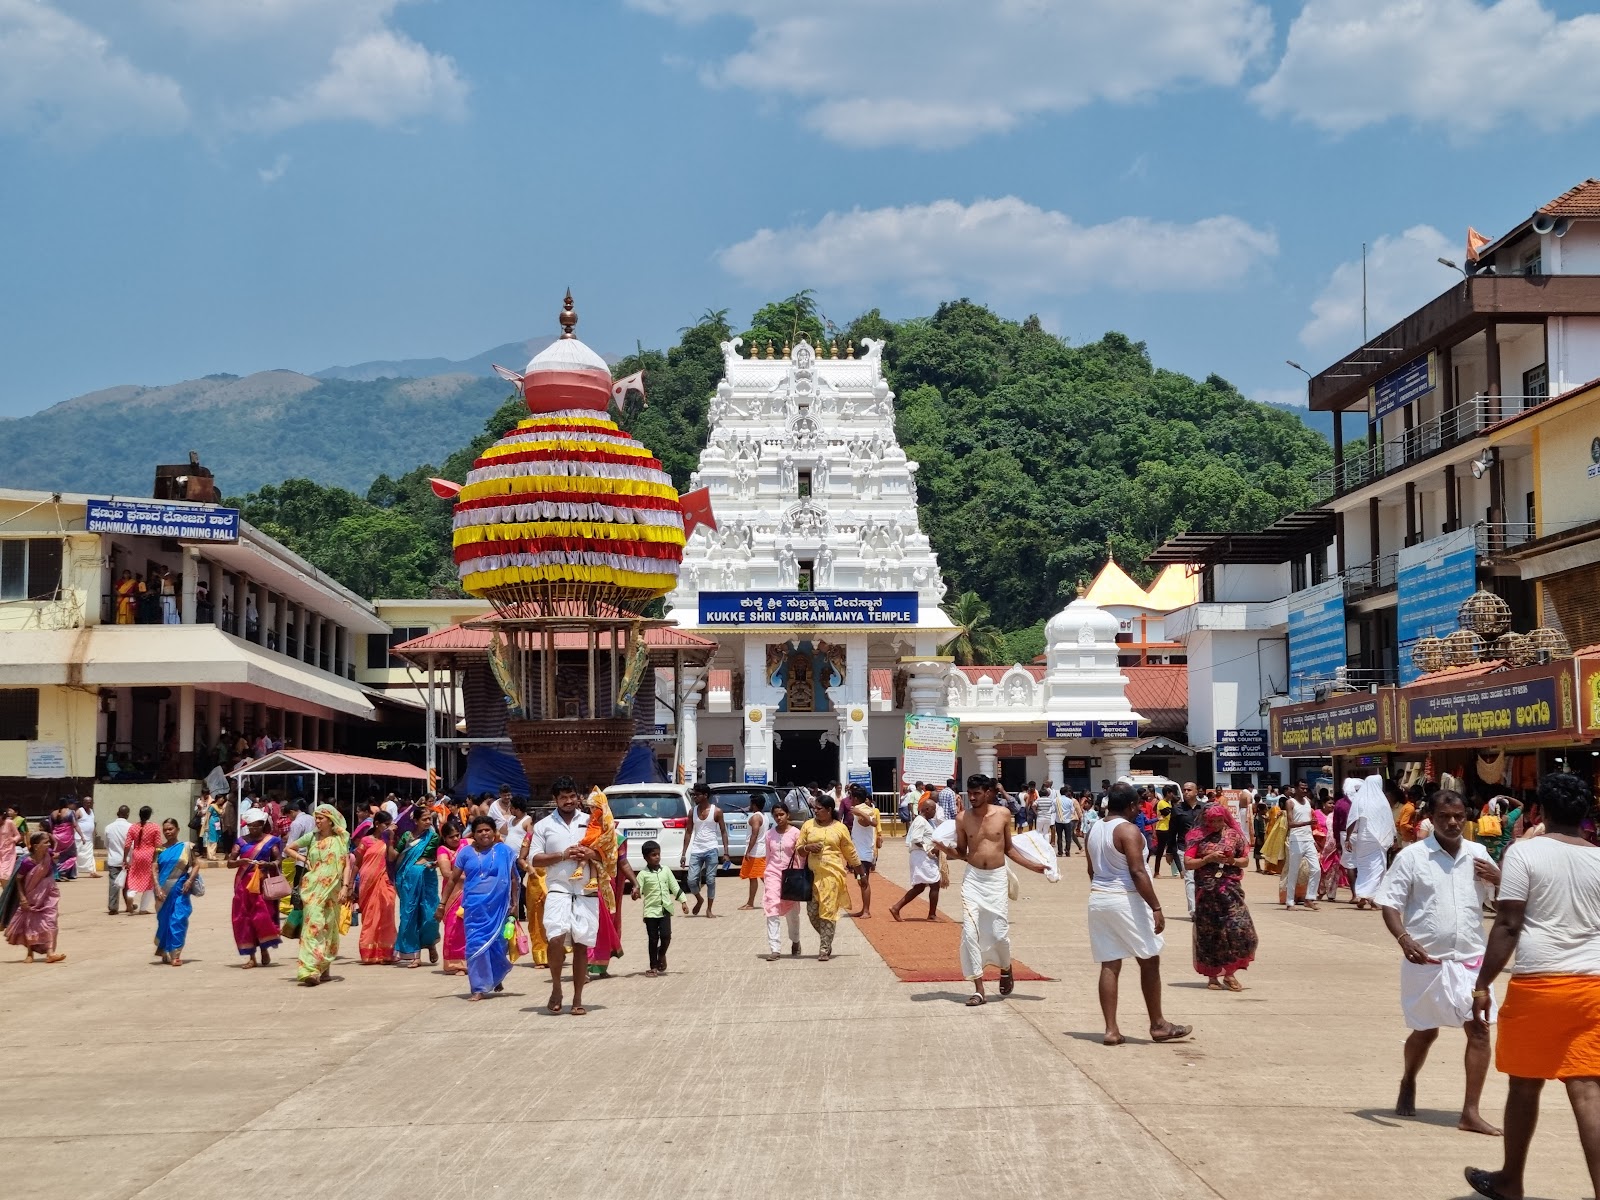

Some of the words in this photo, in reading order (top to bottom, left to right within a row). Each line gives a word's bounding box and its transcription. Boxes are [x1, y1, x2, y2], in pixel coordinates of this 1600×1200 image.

[127, 509, 161, 522] ಪ್ರಸಾದ
[163, 510, 206, 524] ಭೋಜನ
[209, 514, 233, 526] ಶಾಲೆ
[89, 520, 138, 534] SHANMUKA
[140, 524, 180, 537] PRASADA
[180, 526, 211, 538] DINING
[212, 528, 235, 540] HALL
[740, 597, 763, 611] ಕುಕ್ಕೆ
[767, 597, 782, 610] ಶ್ರೀ
[786, 597, 830, 611] ಸುಬ್ರಹ್ಮಣ್ಯ
[833, 597, 883, 611] ದೇವಸ್ಥಾನ
[706, 611, 745, 622] KUKKE
[749, 611, 775, 622] SHRI
[779, 611, 864, 622] SUBRAHMANYA
[868, 611, 910, 622] TEMPLE
